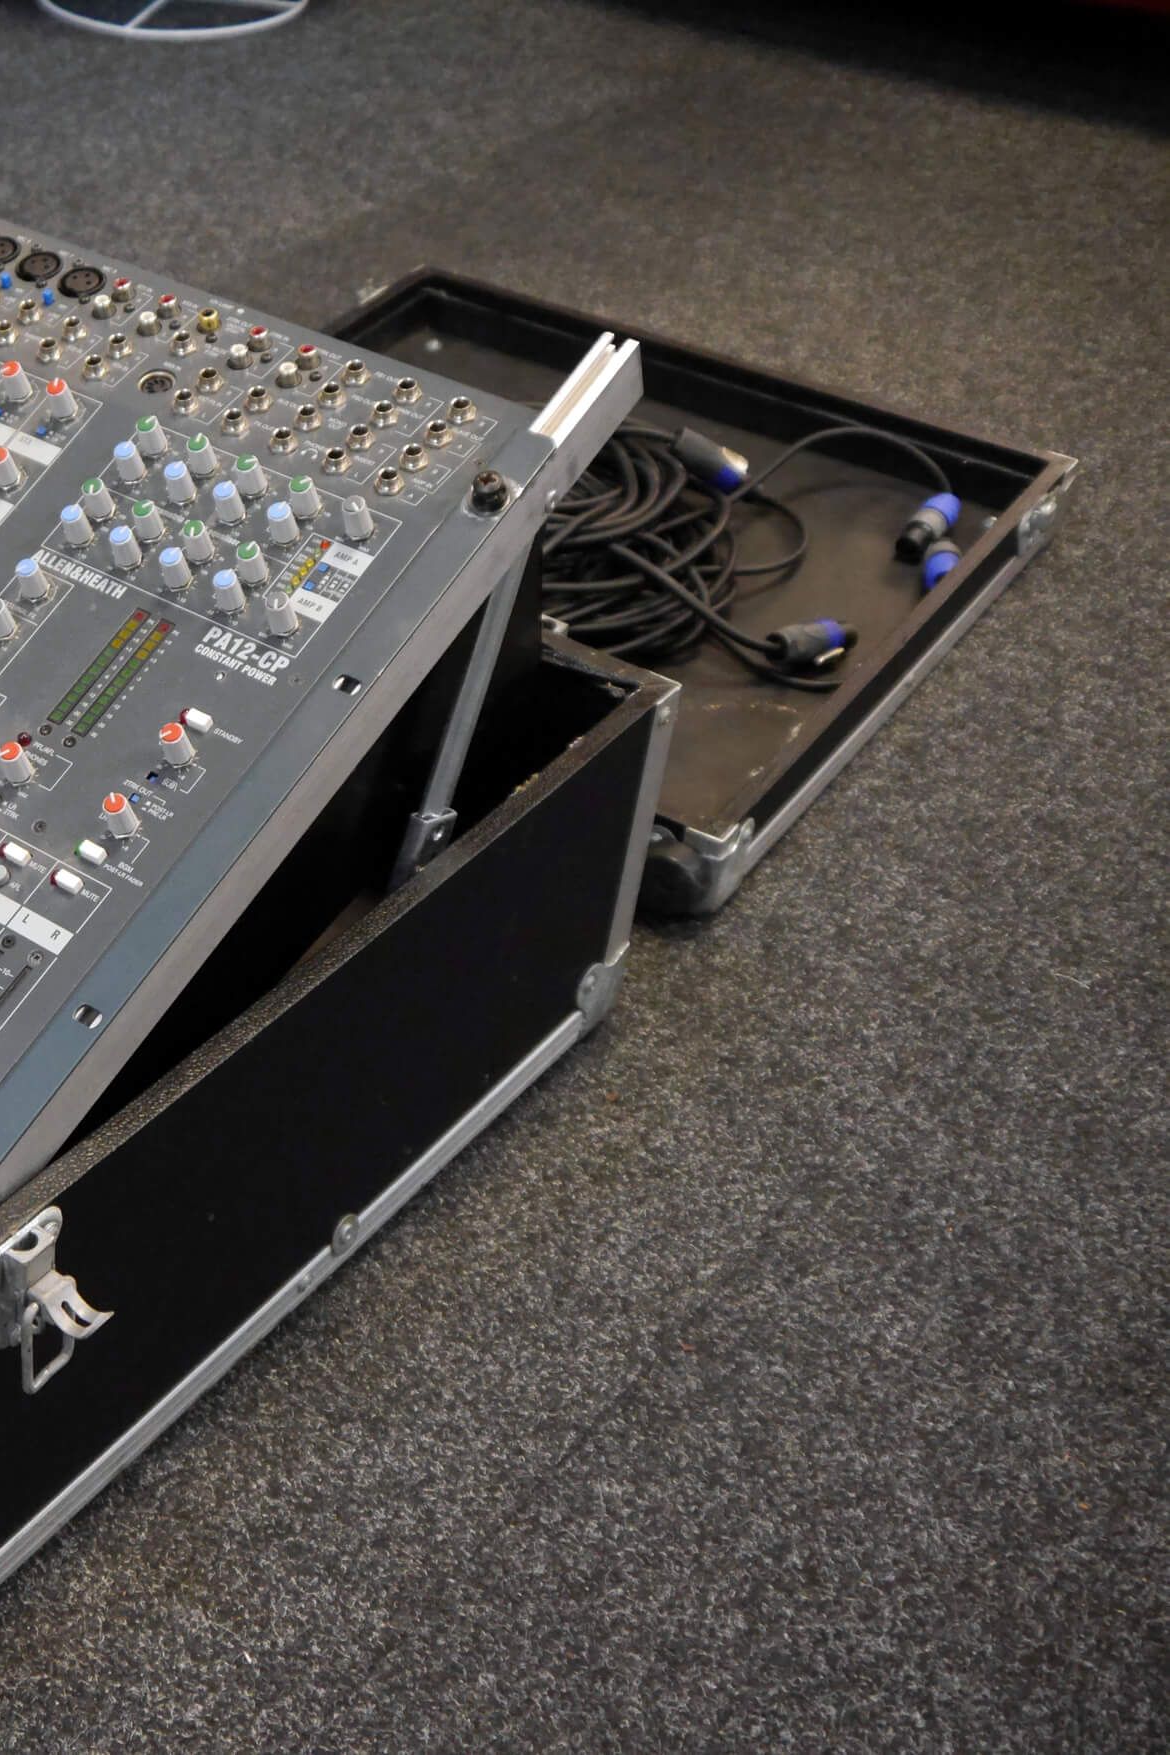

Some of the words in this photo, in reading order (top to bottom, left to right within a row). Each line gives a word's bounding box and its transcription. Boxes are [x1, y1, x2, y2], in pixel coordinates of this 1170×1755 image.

[30, 549, 128, 600] ALLEN&HEATH
[194, 643, 243, 670] CONSTANT
[241, 664, 277, 686] POWER
[202, 626, 290, 673] PA12-CP
[213, 727, 244, 745] STANDBY
[81, 888, 100, 903] MUTE
[22, 913, 29, 924] L
[50, 929, 61, 941] R
